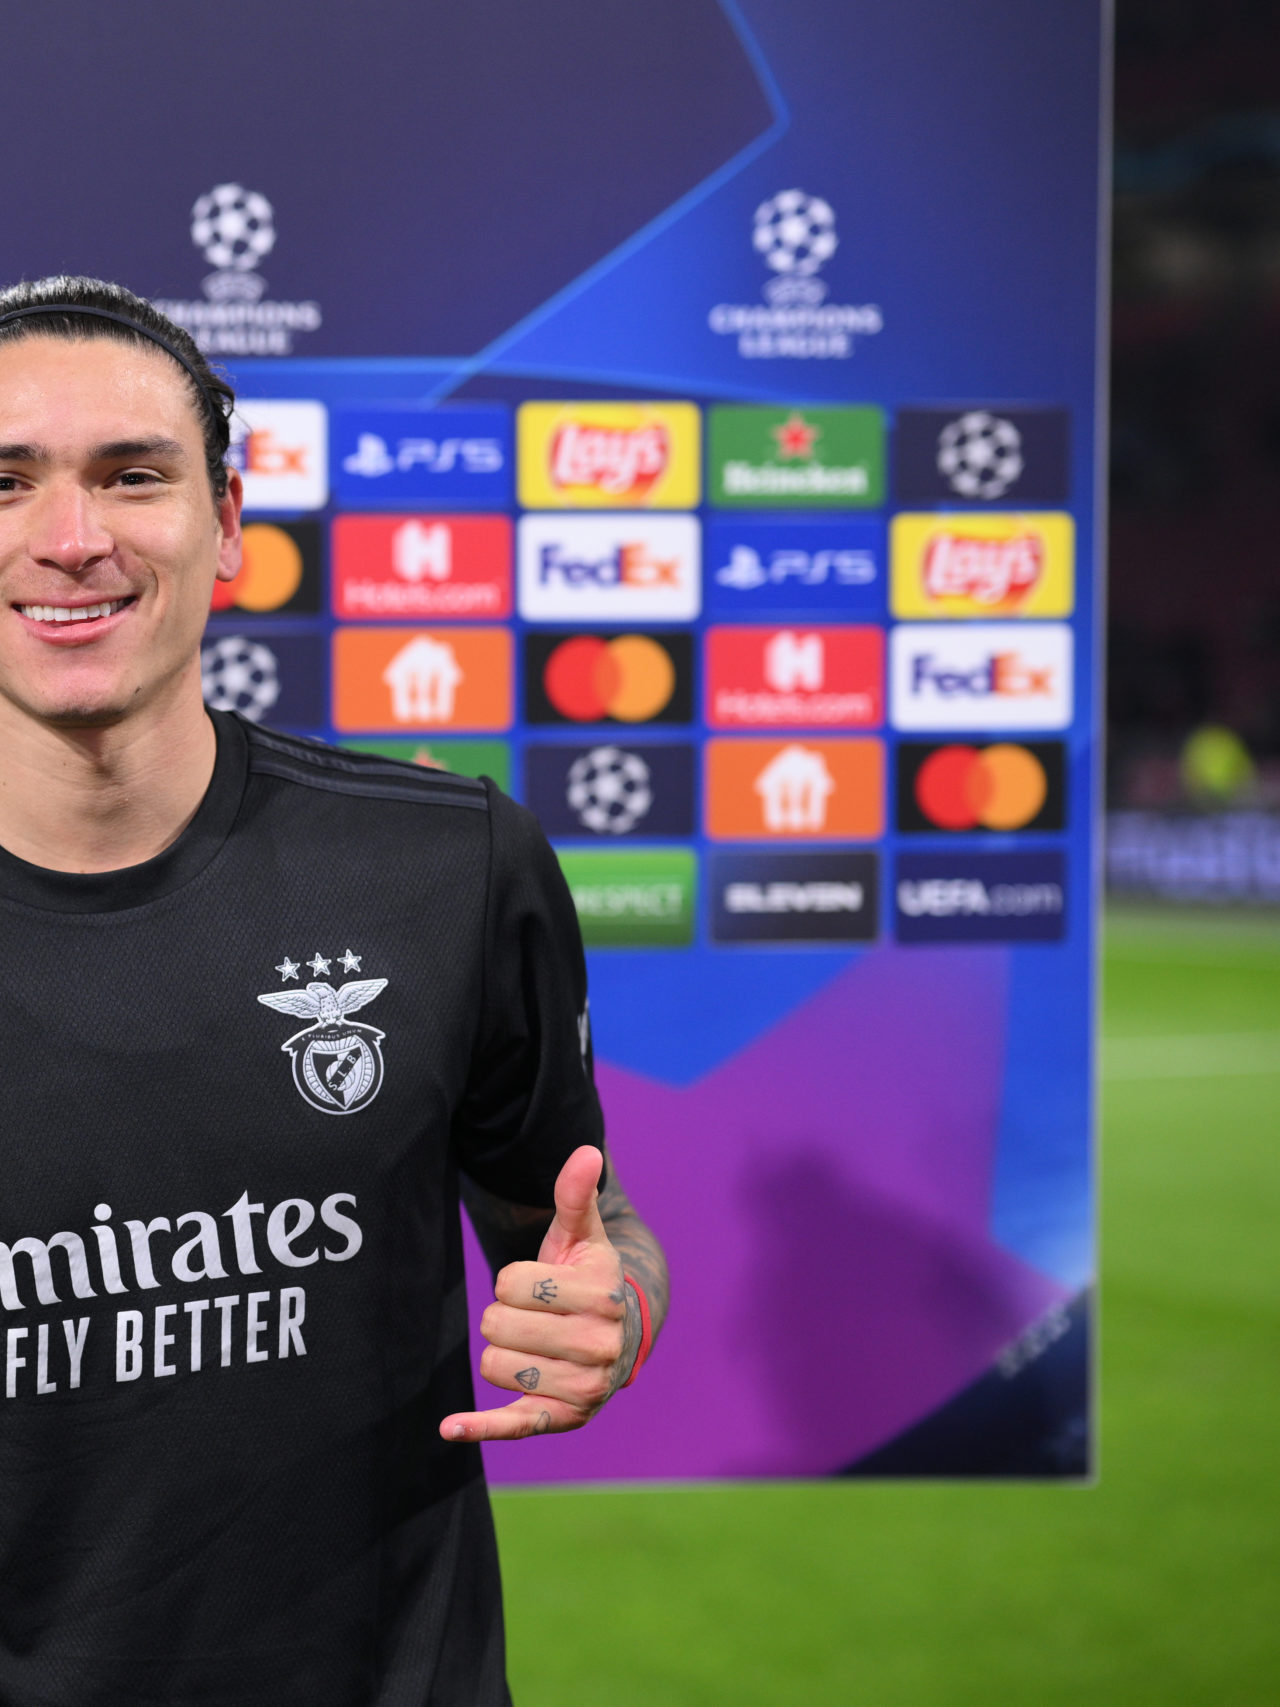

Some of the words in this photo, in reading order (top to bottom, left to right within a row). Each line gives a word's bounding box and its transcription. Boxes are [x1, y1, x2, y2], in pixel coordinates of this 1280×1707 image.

[709, 304, 882, 333] CHAMPIONS
[739, 331, 852, 358] LEAGUE
[397, 437, 502, 473] PS5
[555, 422, 666, 492] Lay's
[723, 462, 868, 494] Heineken
[540, 544, 680, 588] FedEx
[770, 550, 876, 584] PS5
[927, 533, 1037, 604] Lay's
[344, 580, 500, 612] Hotels.com
[914, 654, 1054, 697] FedEx
[716, 692, 872, 722] Hotels.com
[725, 883, 862, 911] ELEVEN
[896, 879, 1062, 916] UEFA.com
[6, 1317, 90, 1398] FLY
[116, 1287, 307, 1382] BETTER
